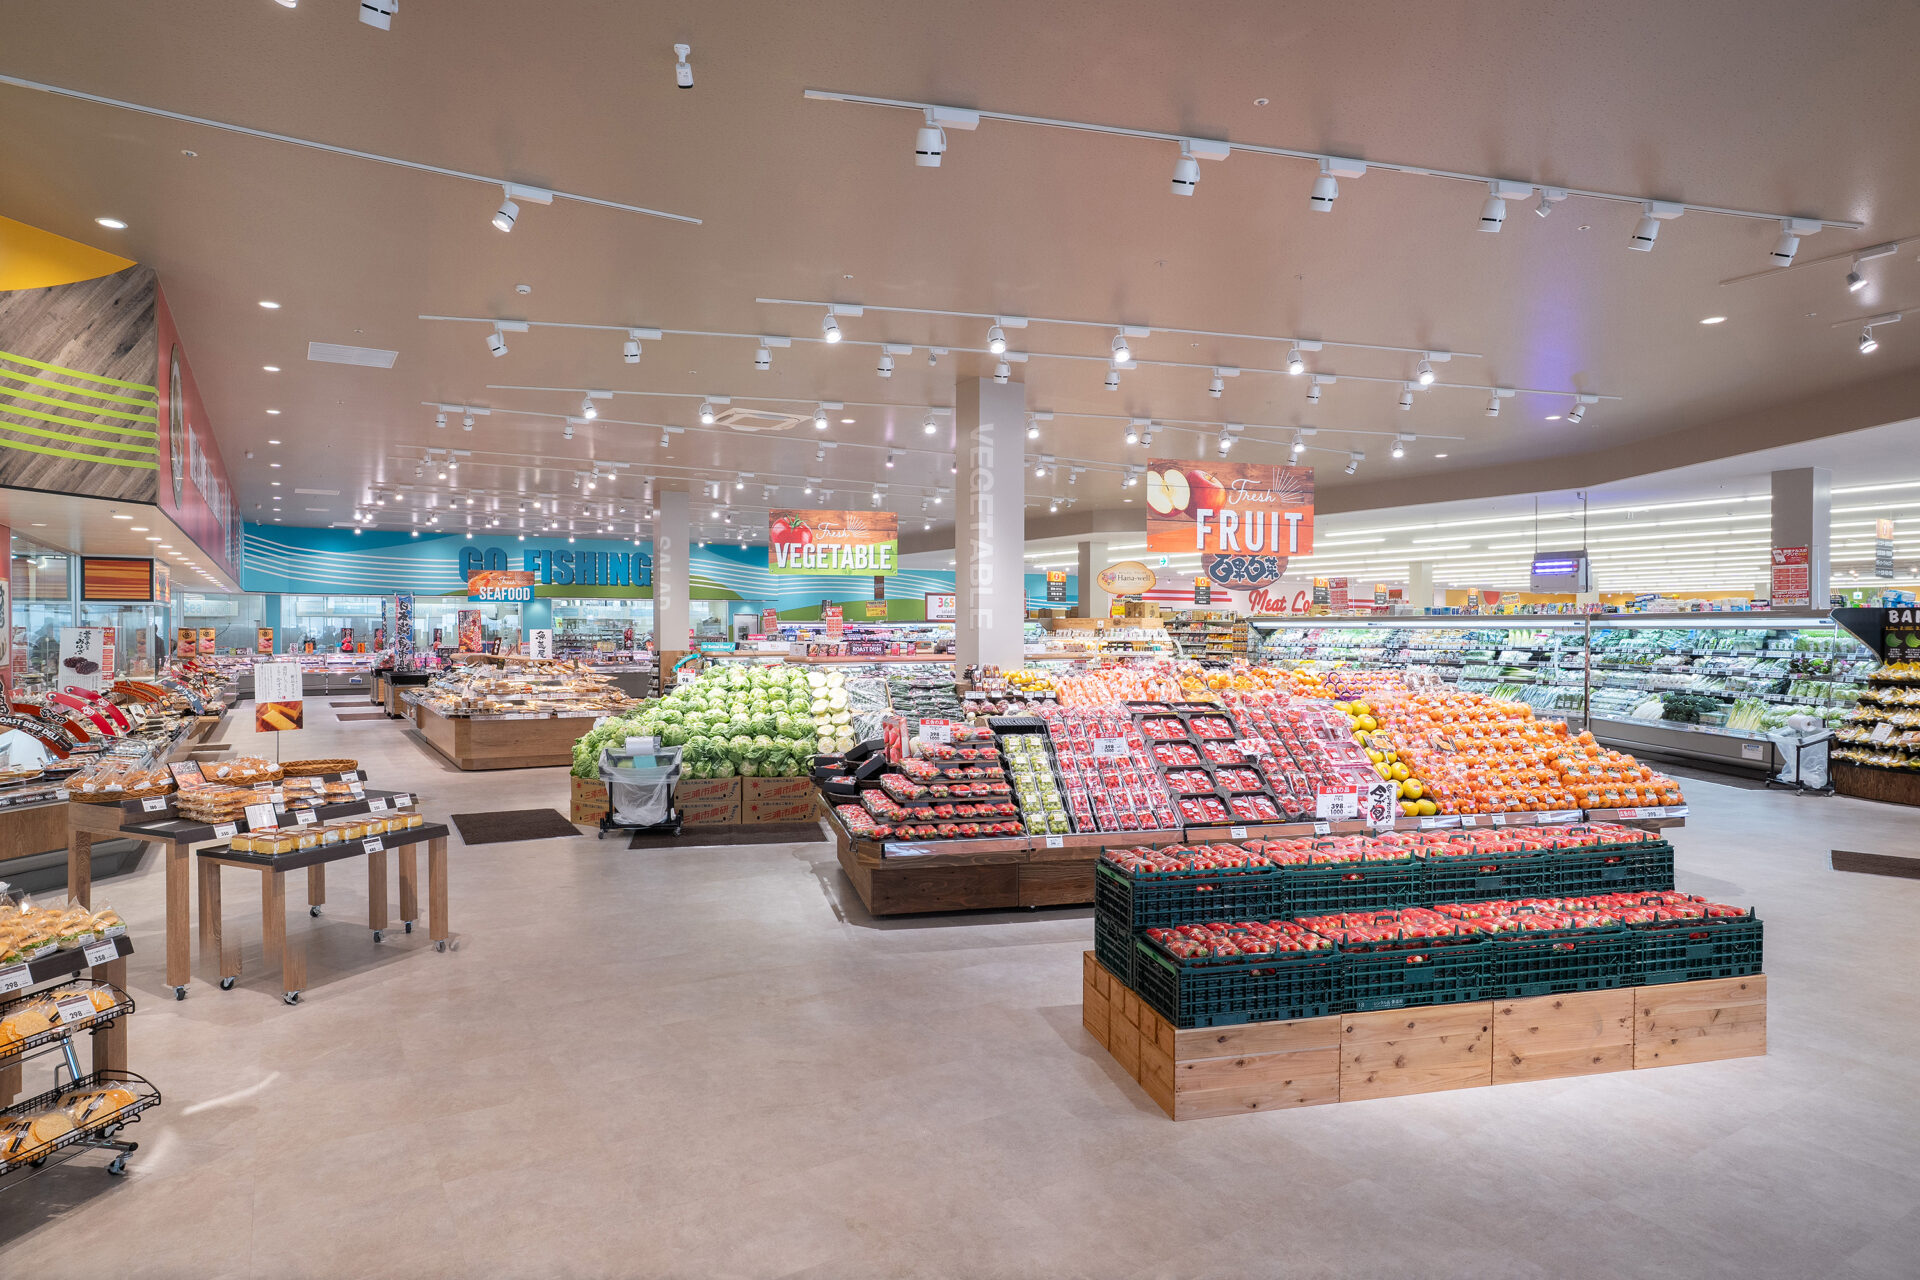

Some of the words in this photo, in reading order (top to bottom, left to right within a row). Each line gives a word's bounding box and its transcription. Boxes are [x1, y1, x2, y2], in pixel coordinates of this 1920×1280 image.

[1229, 478, 1277, 505] Fresh
[816, 522, 850, 540] Fresh
[969, 423, 995, 631] VEGETABLE
[1196, 508, 1304, 554] FRUIT
[523, 549, 652, 587] FISHING
[774, 542, 893, 570] VEGETABLE
[1117, 574, 1151, 582] Hana-well
[479, 586, 531, 602] SEAFOOD
[938, 597, 955, 608] 365
[1248, 588, 1297, 613] Meat
[0, 716, 23, 726] OAST
[23, 721, 43, 733] BEEF
[42, 728, 60, 741] DELI
[4, 981, 19, 990] 298
[69, 1010, 83, 1020] 298
